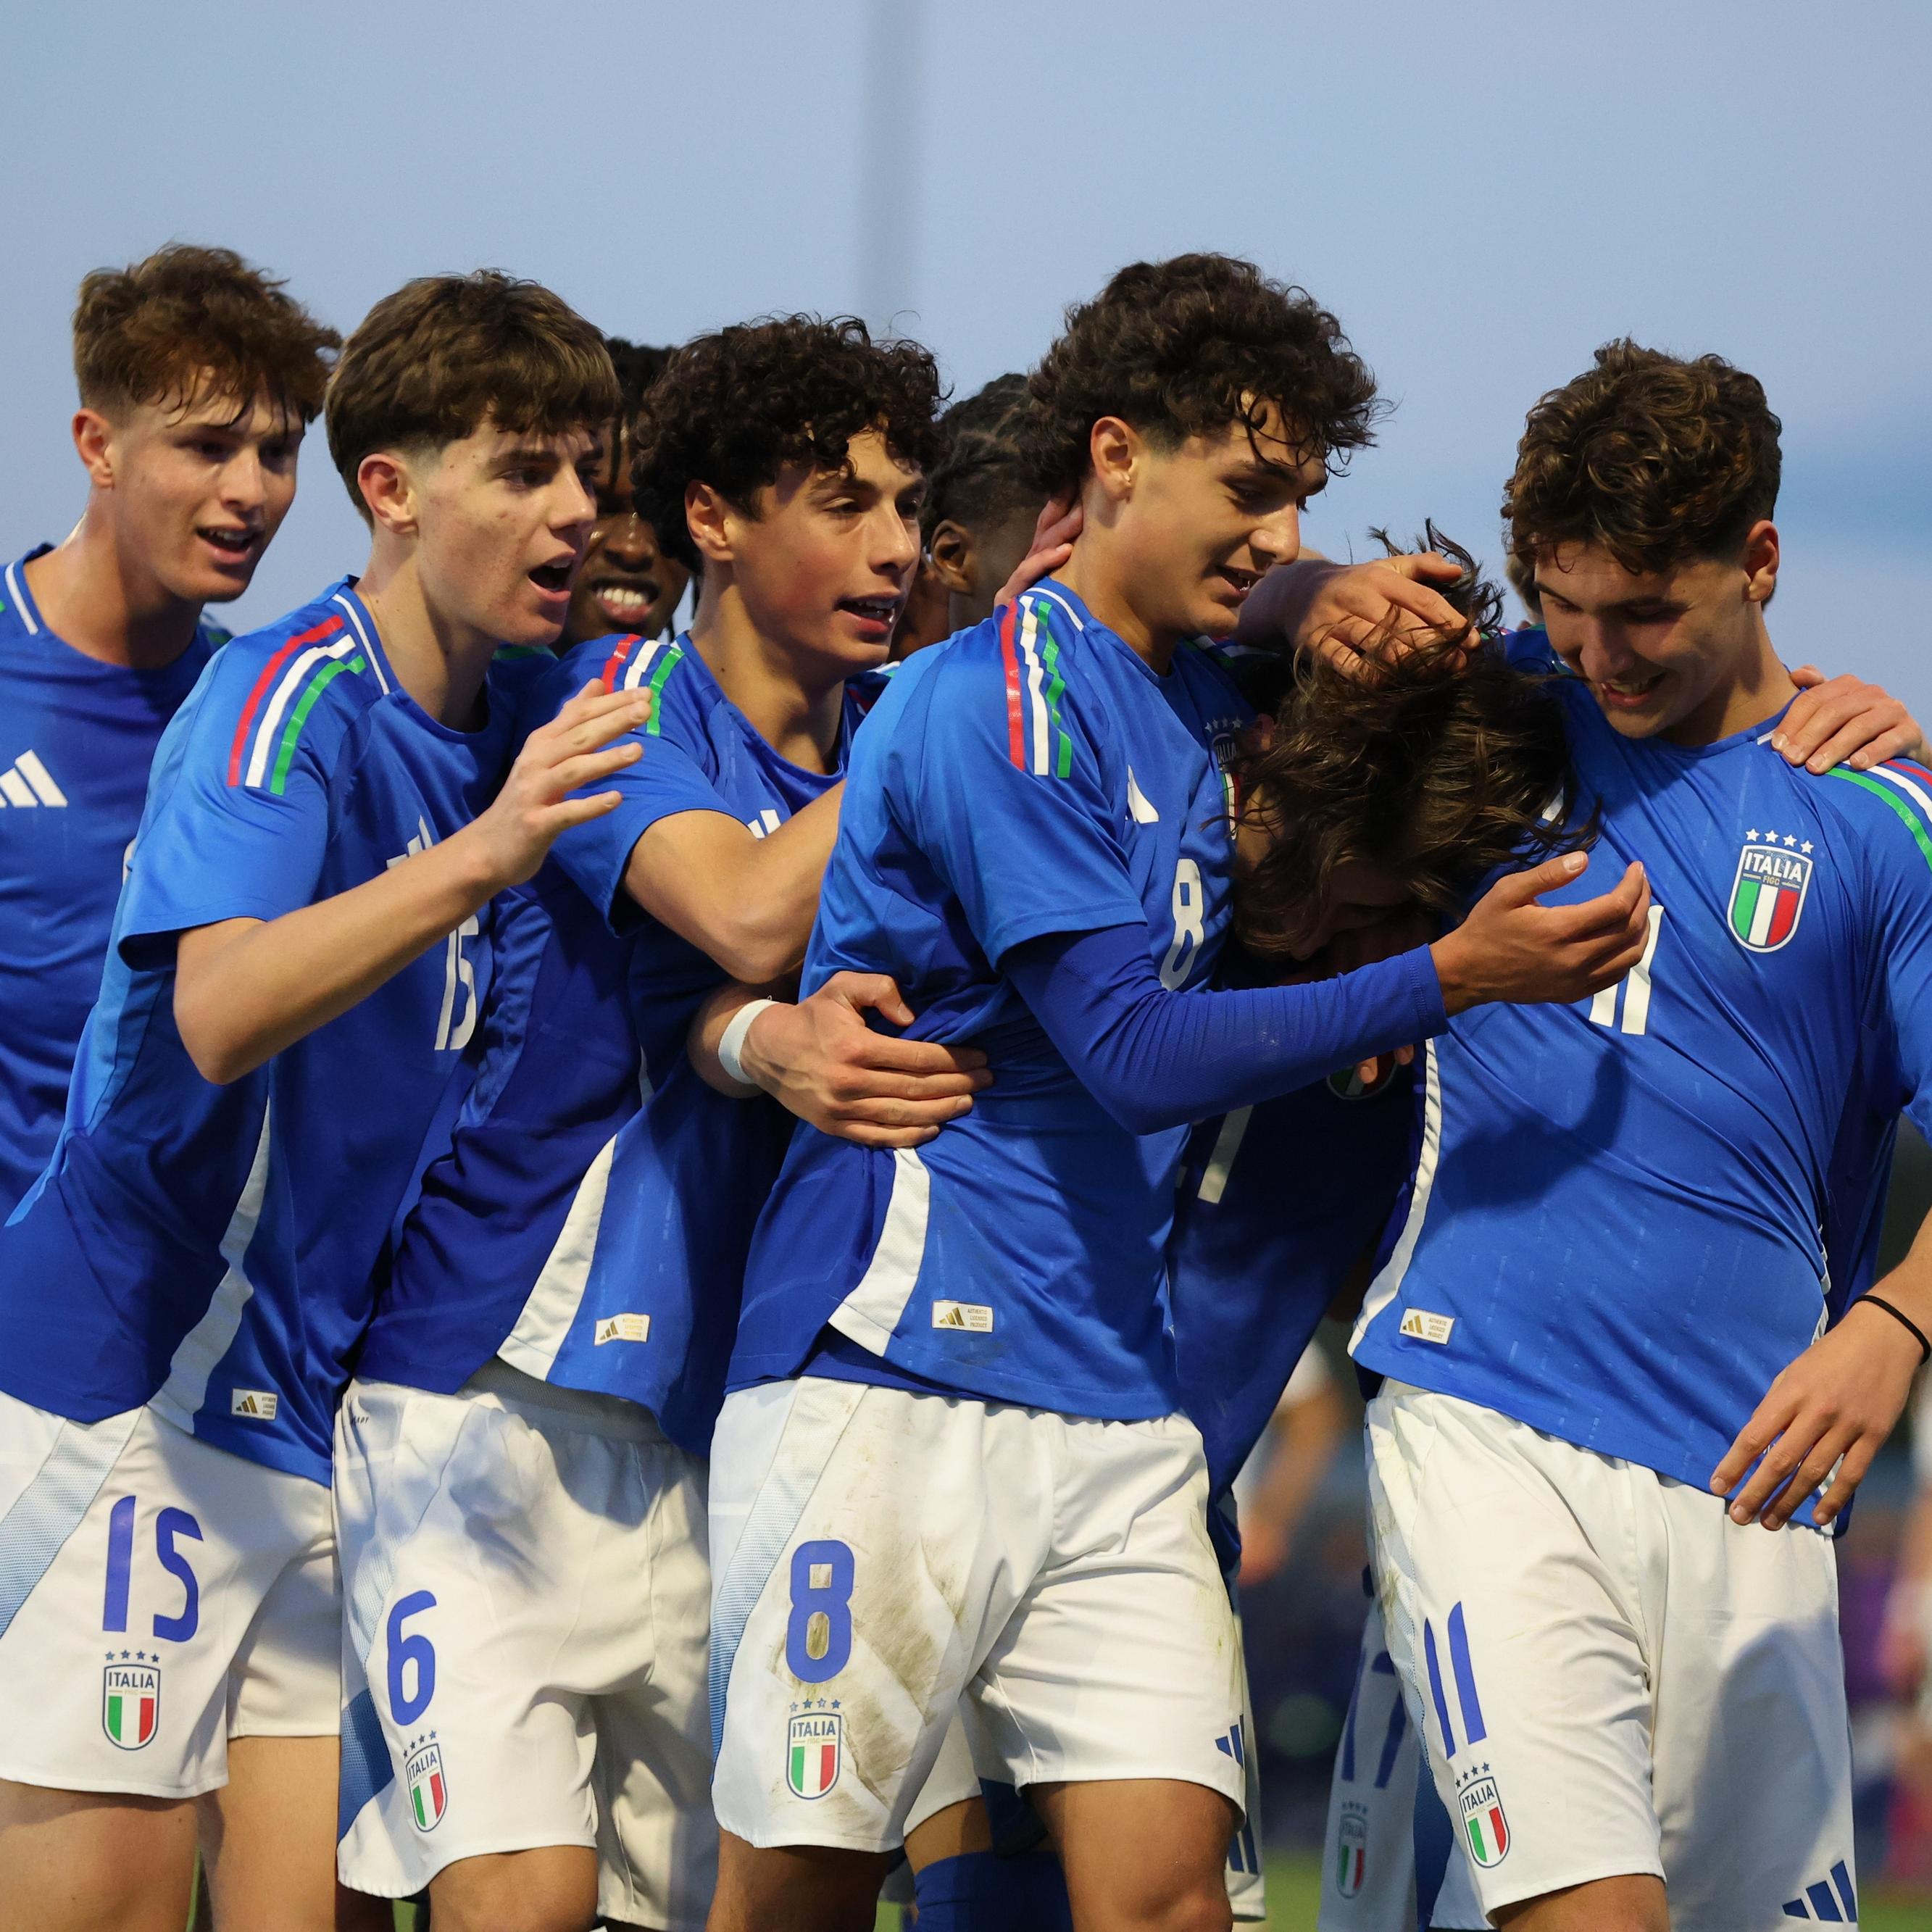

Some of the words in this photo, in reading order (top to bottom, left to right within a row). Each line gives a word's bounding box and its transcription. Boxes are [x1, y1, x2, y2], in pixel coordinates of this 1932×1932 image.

[1744, 852, 1802, 883] ITALIA
[1762, 875, 1780, 886] FIGC
[1159, 859, 1204, 991] 8
[435, 915, 479, 1050] 15
[102, 1496, 204, 1642] 15
[786, 1540, 854, 1683] 8
[109, 1672, 154, 1689] ITALIA
[386, 1590, 437, 1725] 6
[1424, 1600, 1487, 1761] 11
[409, 1751, 437, 1781] ITALIA
[792, 1720, 836, 1737] ITALIA
[1462, 1784, 1494, 1812] ITALIA
